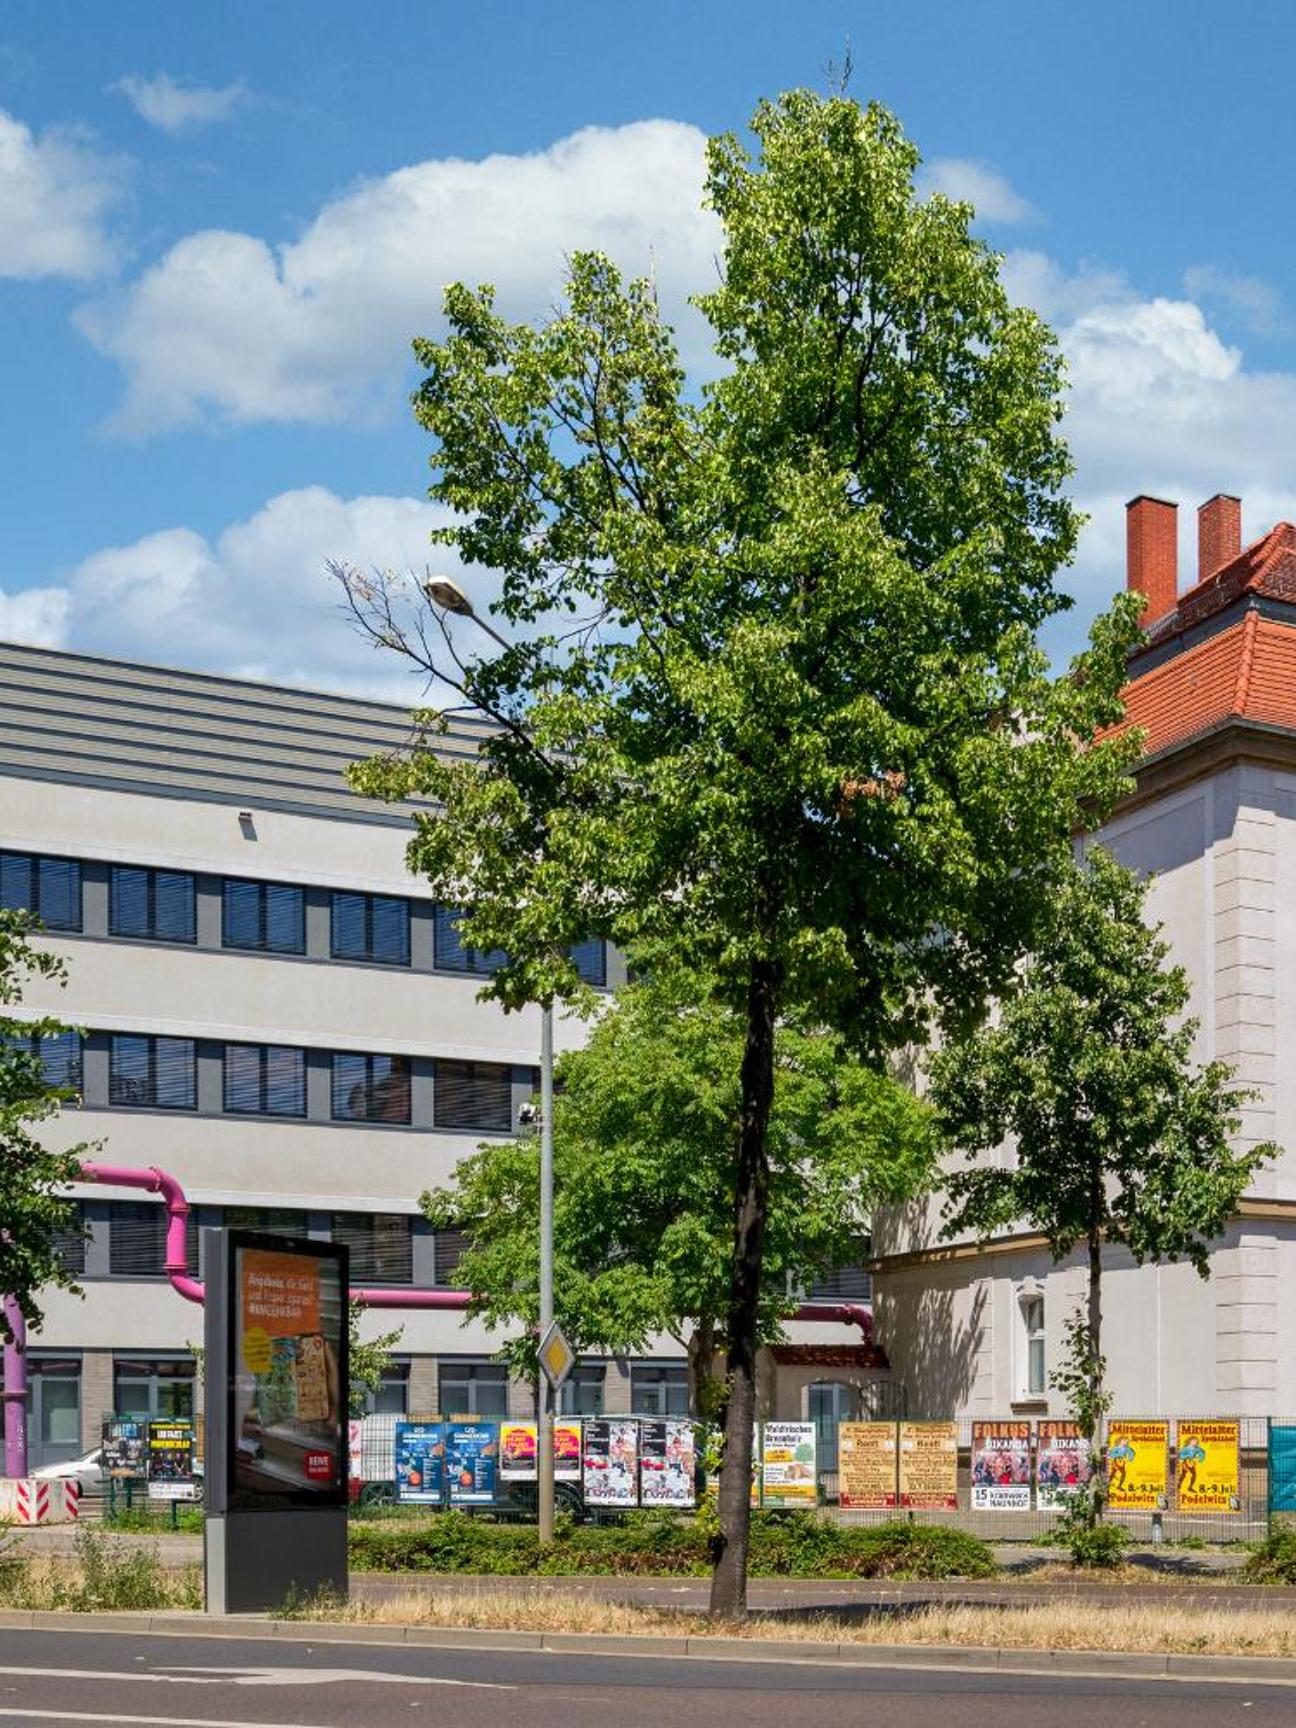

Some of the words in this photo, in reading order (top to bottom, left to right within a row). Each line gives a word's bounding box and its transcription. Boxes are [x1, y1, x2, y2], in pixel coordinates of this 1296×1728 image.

[1112, 1425, 1165, 1435] Mittelalter
[1181, 1425, 1235, 1435] Mittelalter
[975, 1489, 988, 1500] 15
